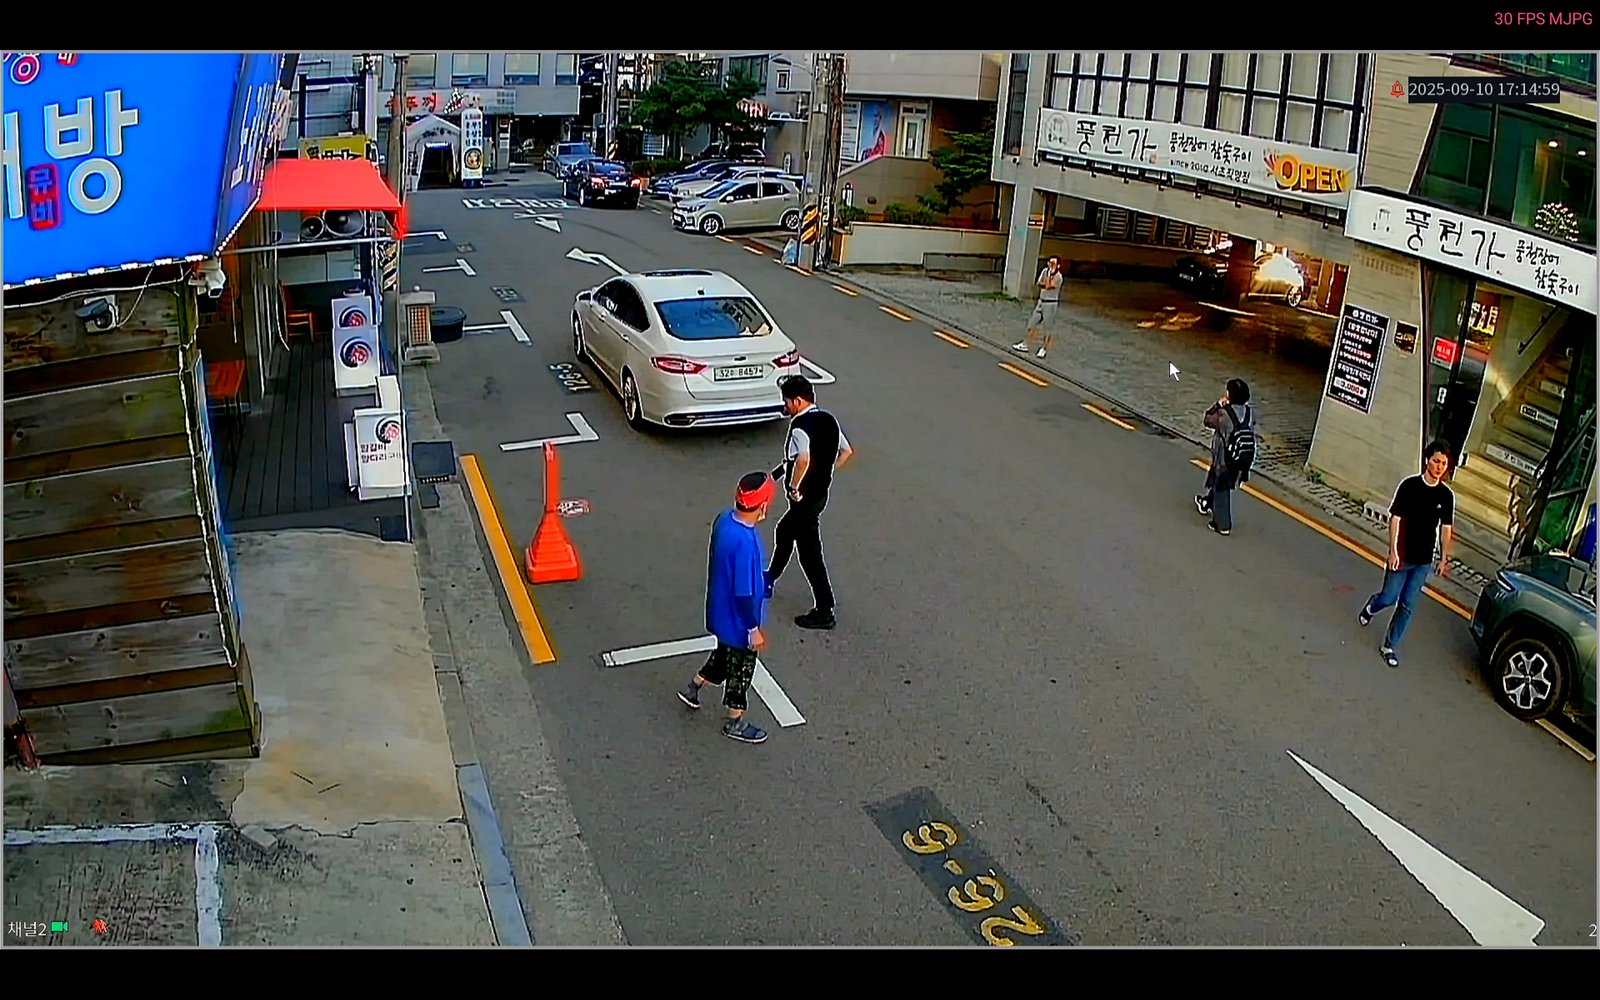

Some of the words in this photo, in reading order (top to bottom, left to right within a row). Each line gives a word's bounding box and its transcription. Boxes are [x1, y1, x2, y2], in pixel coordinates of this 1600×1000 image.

[1190, 161, 1209, 173] 2010
[1274, 154, 1347, 193] OPEN
[1515, 239, 1560, 266] 풍천장어
[1534, 266, 1580, 296] 참숯구이
